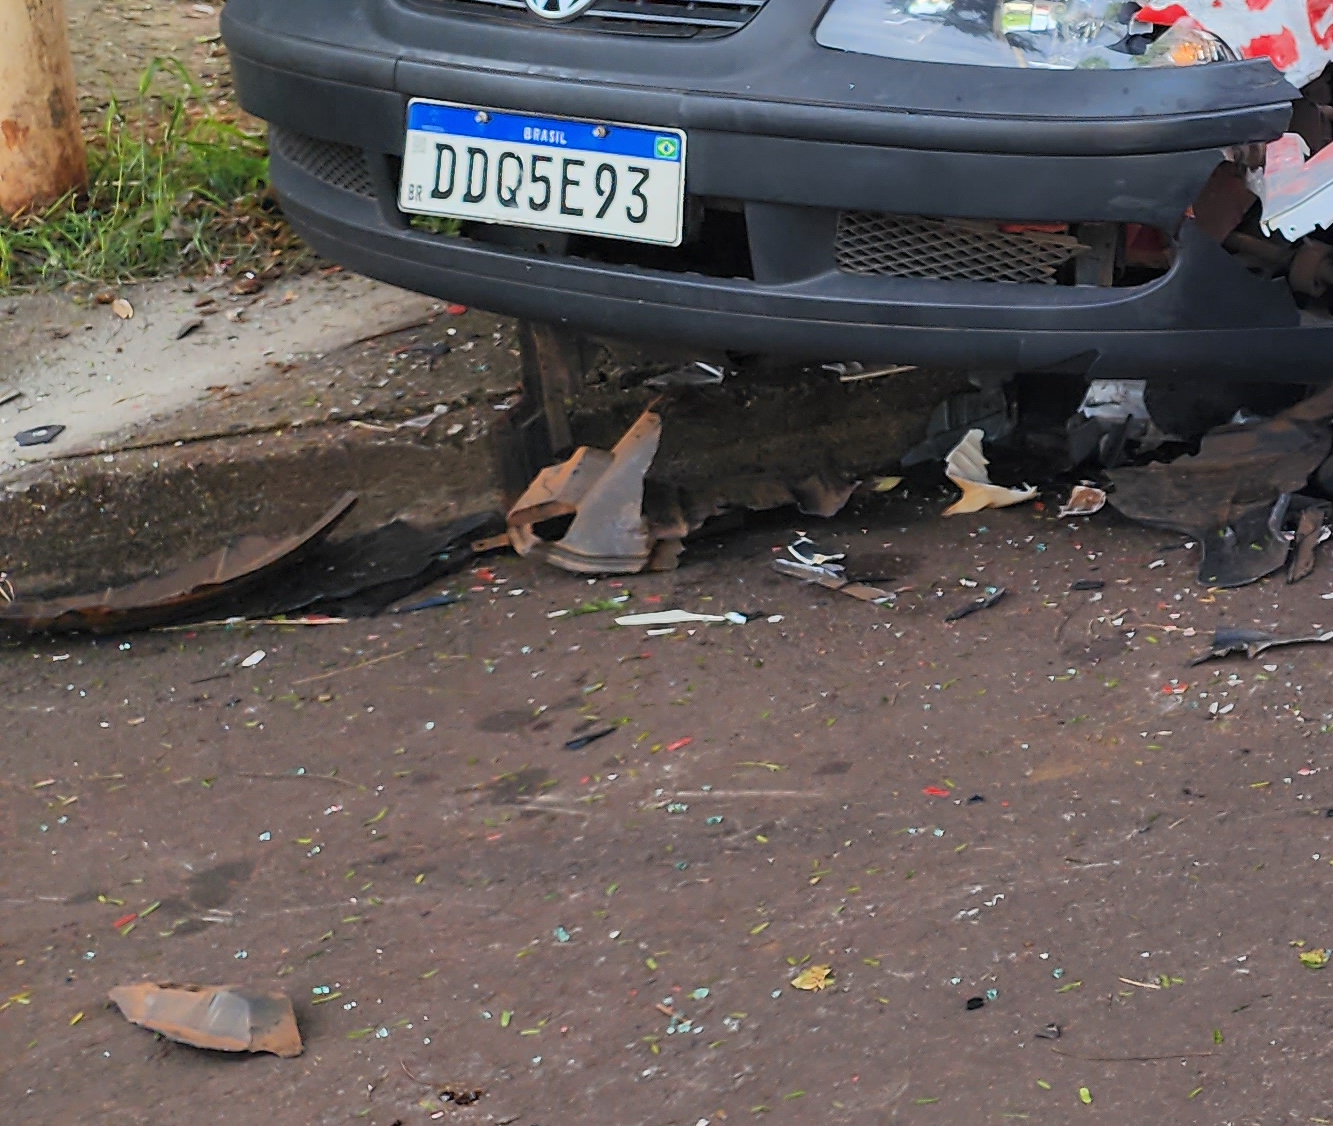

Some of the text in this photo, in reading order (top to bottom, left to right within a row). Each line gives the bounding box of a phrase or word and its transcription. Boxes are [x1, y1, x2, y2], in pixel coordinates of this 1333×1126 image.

[523, 126, 567, 145] BRASIL
[408, 184, 422, 201] BR
[430, 142, 650, 224] DDQ5E93
